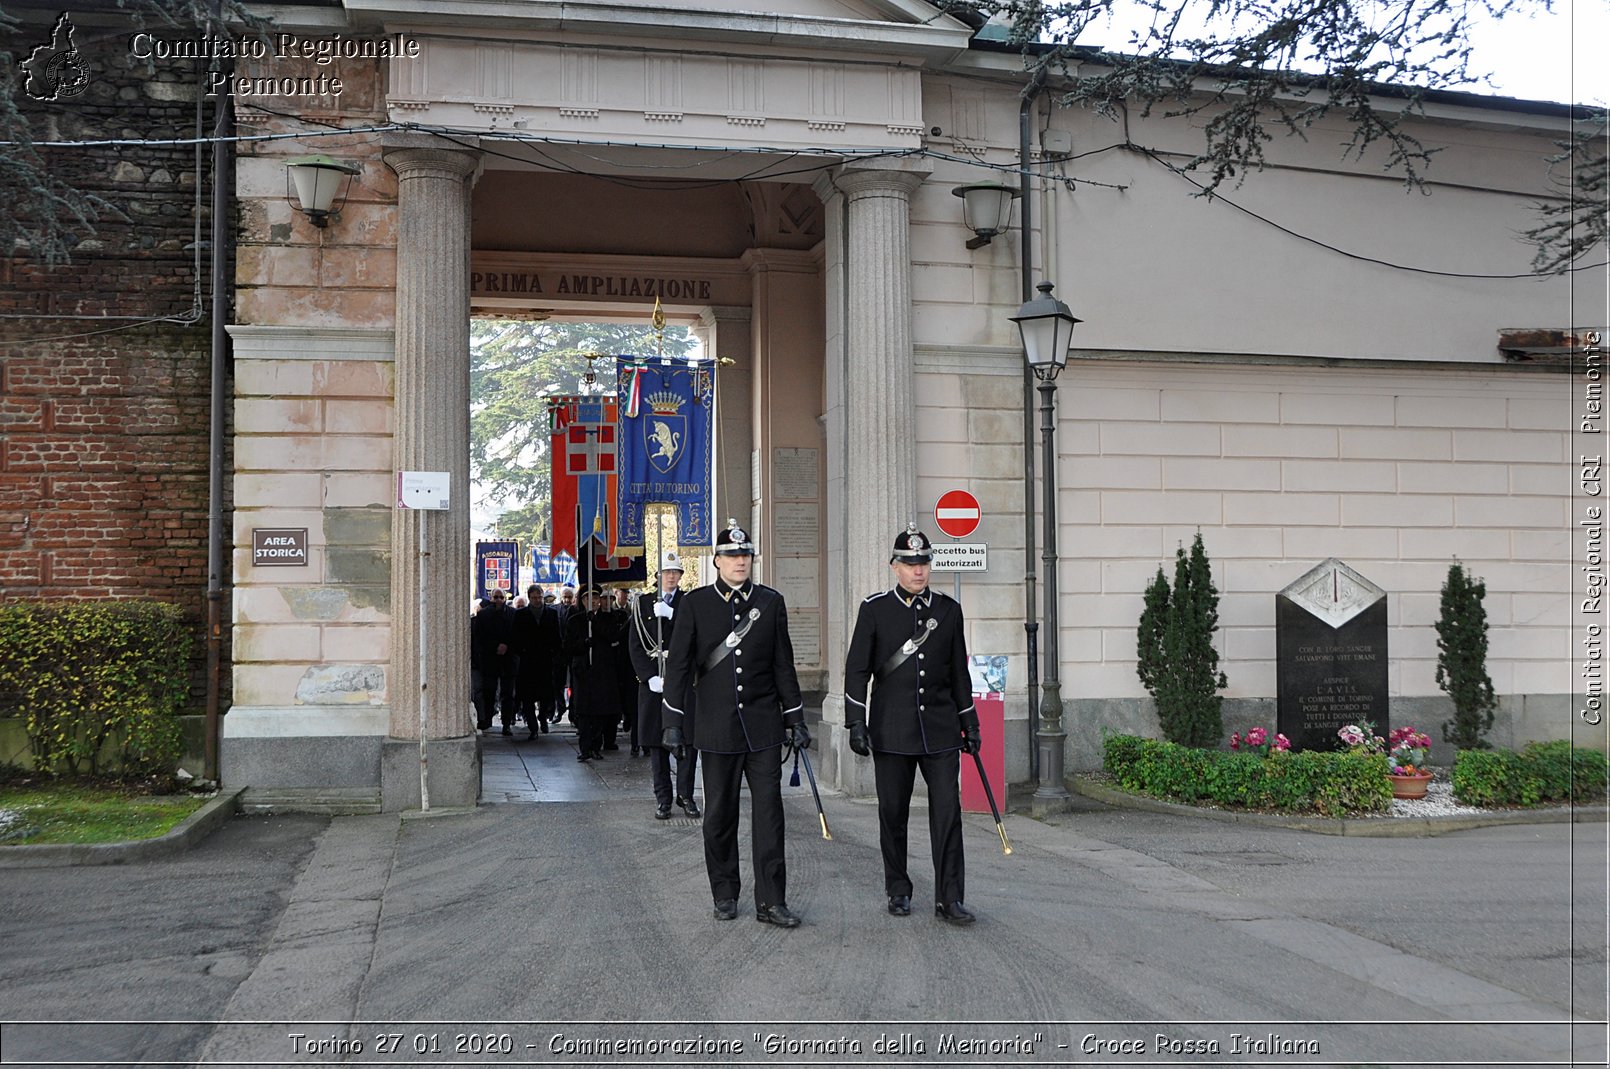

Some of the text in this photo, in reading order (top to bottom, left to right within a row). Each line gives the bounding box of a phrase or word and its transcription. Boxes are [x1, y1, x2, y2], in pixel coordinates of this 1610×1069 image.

[470, 272, 711, 299] PRIMA AMPLIAZIONE
[655, 482, 665, 494] DI
[666, 482, 700, 494] TORINO
[264, 536, 296, 545] AREA
[256, 548, 304, 557] STORICA
